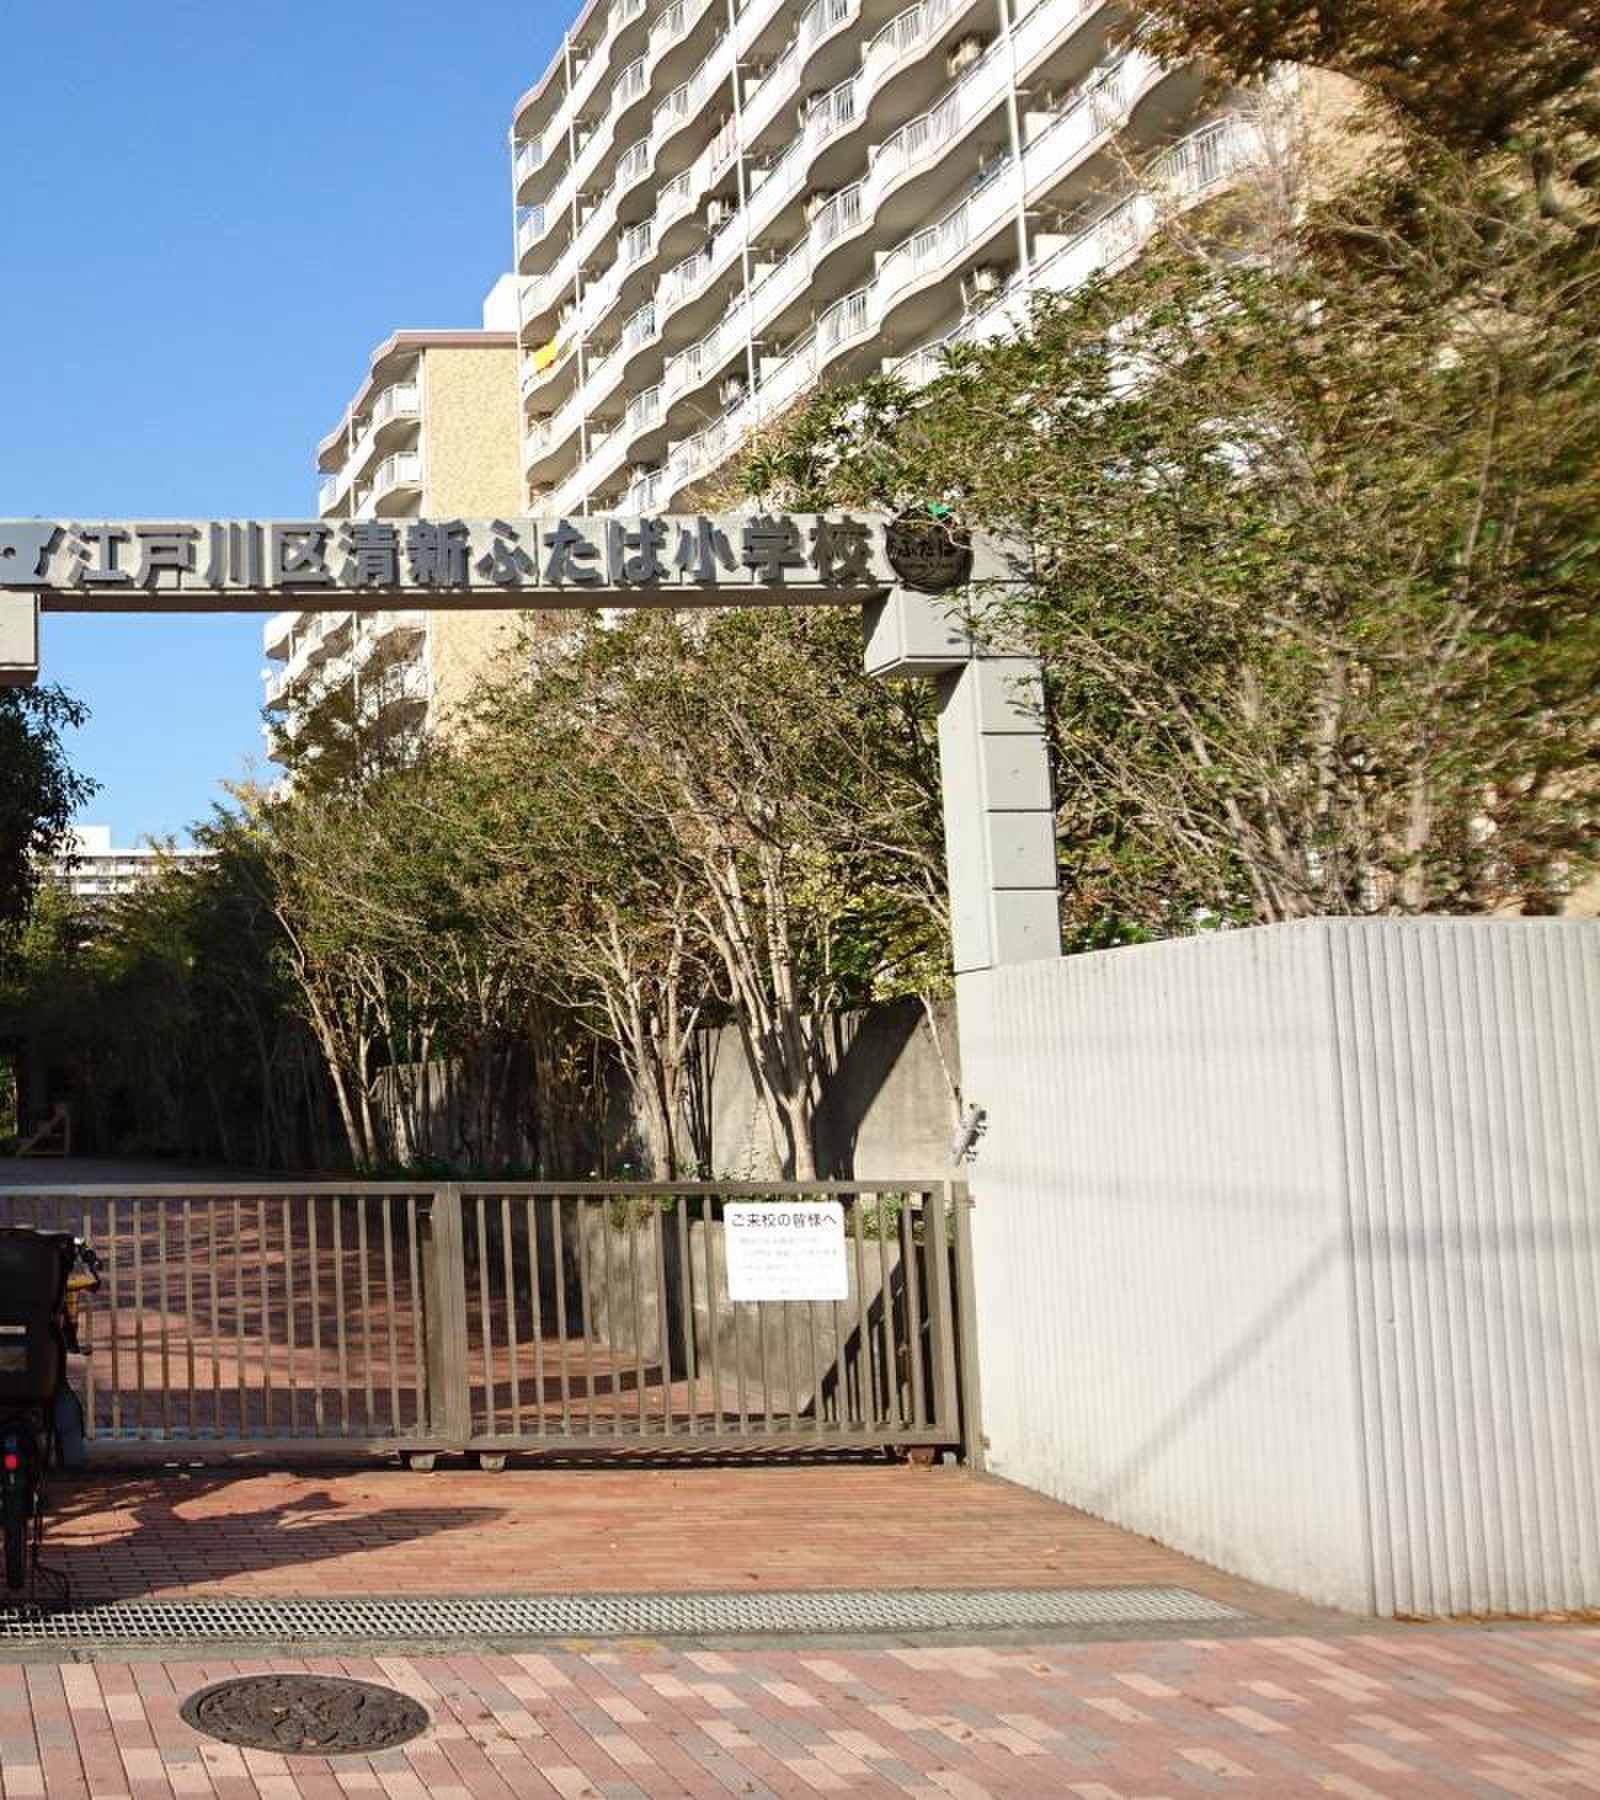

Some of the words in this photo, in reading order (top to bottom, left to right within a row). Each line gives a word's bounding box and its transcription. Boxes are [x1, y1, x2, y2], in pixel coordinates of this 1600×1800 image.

[68, 515, 875, 588] 江戸川区清新ふたば小学校
[731, 1212, 838, 1228] ご来校の皆様へ
